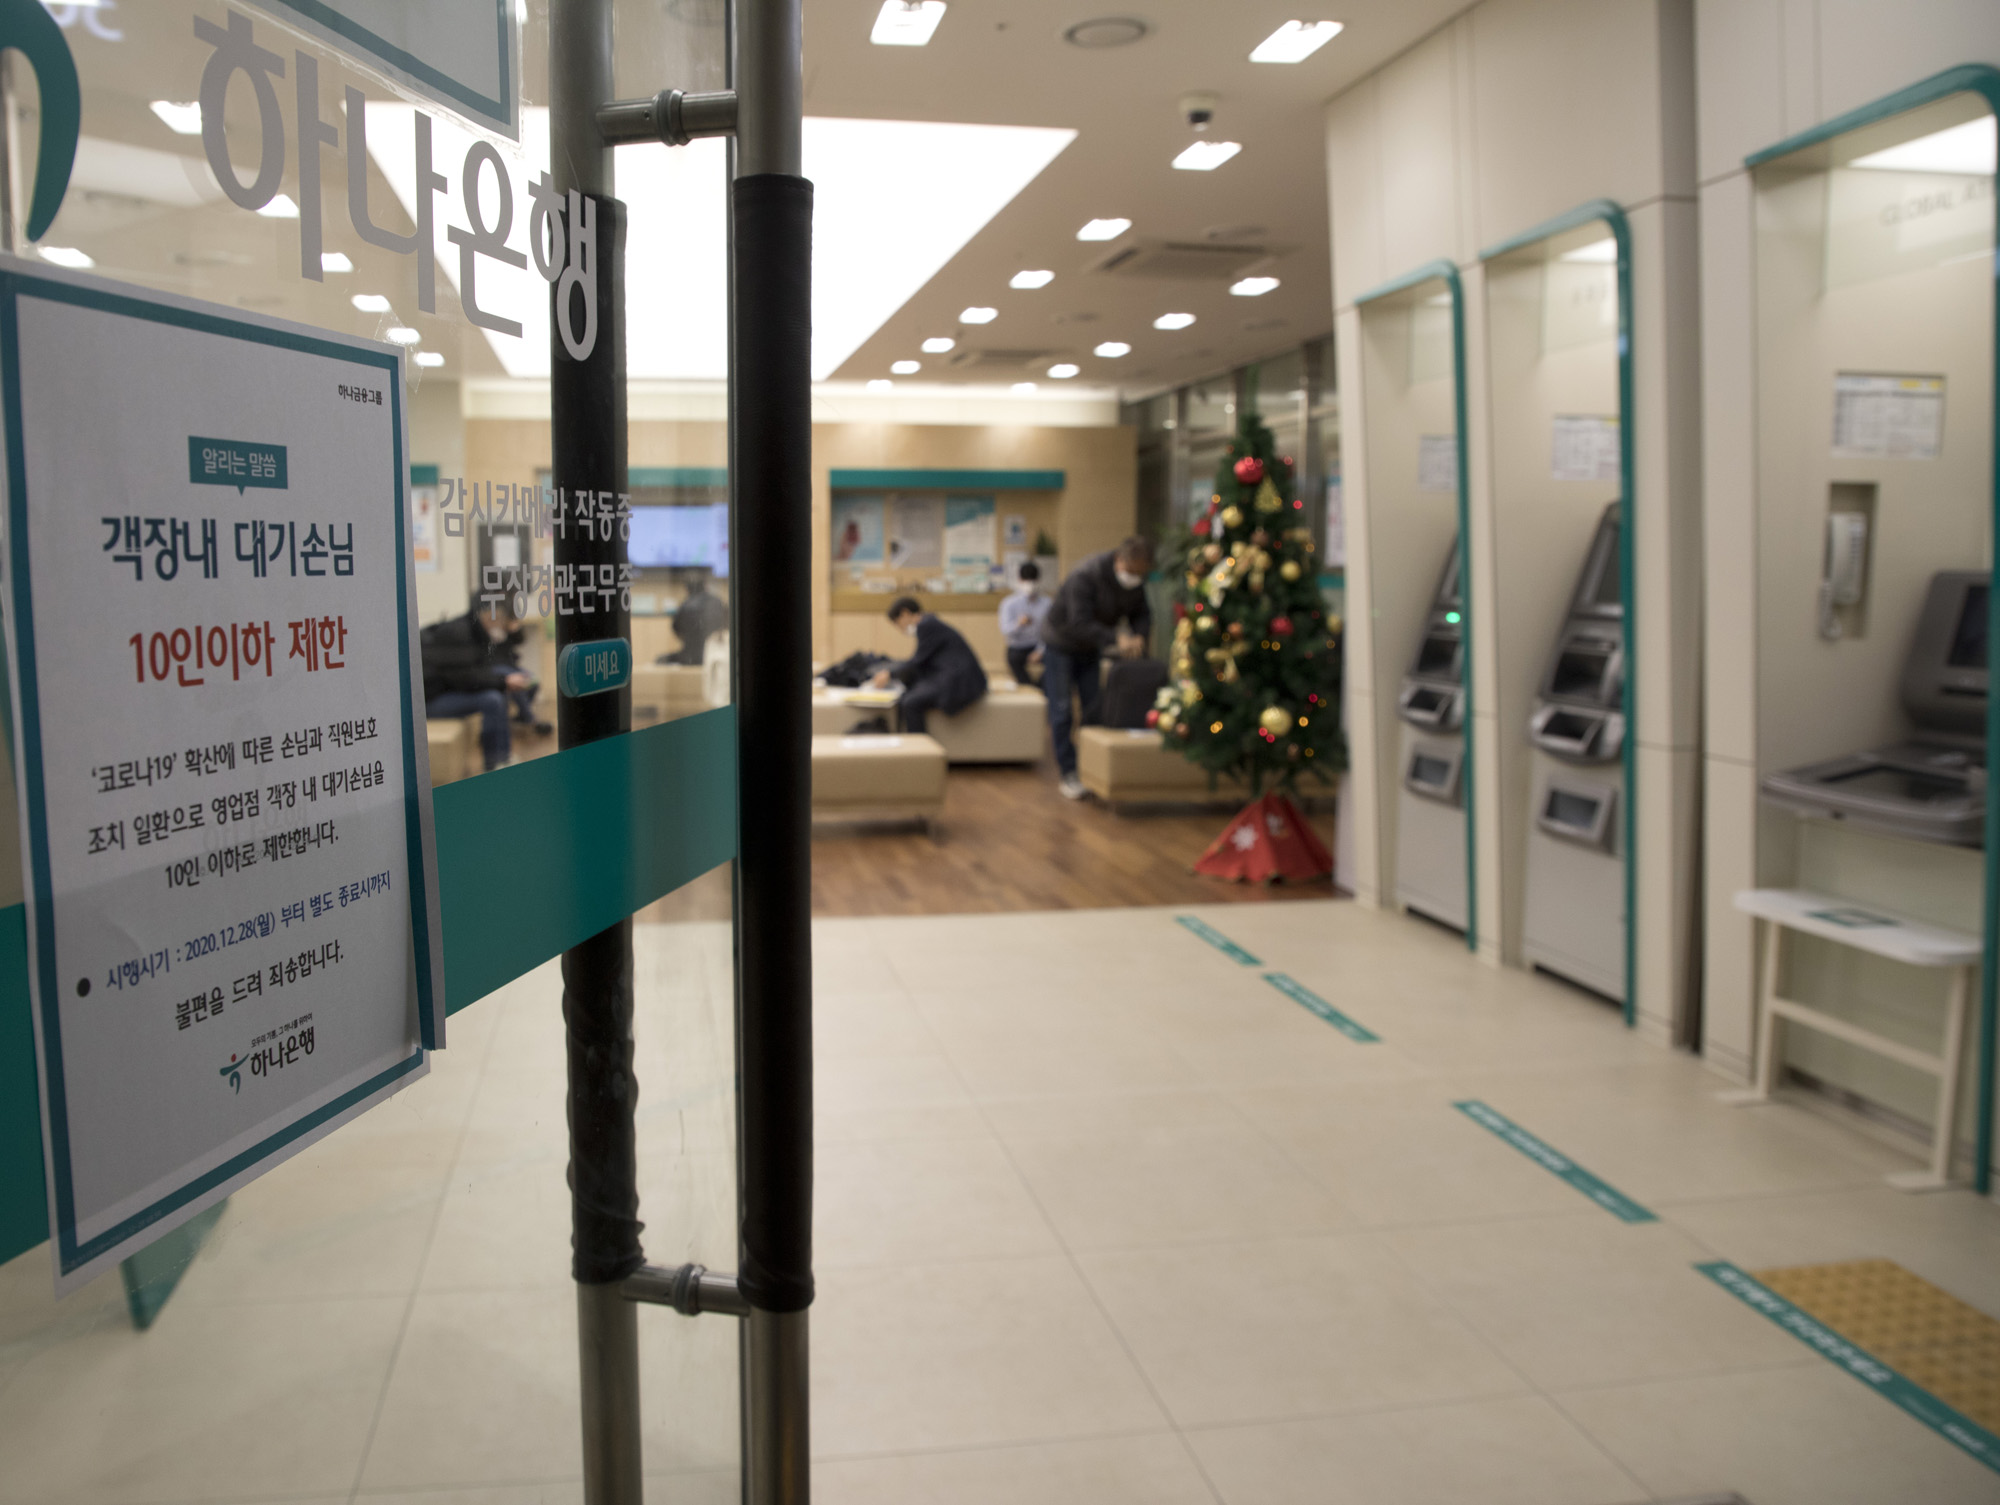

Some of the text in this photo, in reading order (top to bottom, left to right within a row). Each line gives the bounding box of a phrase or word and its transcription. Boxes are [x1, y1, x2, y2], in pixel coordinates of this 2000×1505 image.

[194, 8, 597, 361] 하나은행
[337, 383, 383, 406] 하나금융그룹
[202, 447, 277, 478] 알리는 말씀
[439, 477, 634, 542] 감시카메라 작동중
[101, 515, 354, 582] 객장내 대기손님
[129, 615, 348, 688] 10인이하 제한
[584, 649, 620, 683] 미세요
[184, 741, 236, 777] 확산에
[242, 735, 274, 765] 따른
[280, 726, 323, 759] 손님과
[328, 716, 379, 749] 직원보호
[88, 760, 385, 855] 조치 일환으로 영업점 객장 내 대기손님을
[165, 819, 340, 889] 10인 이하로 제한합니다.
[106, 947, 171, 991] 시행시기
[184, 910, 276, 962] 2020.12.28(월)
[280, 900, 306, 929] 부터
[309, 891, 335, 919] 별도
[338, 870, 391, 908] 종료시까지
[175, 938, 345, 1032] 불편을 드려 죄송합니다.
[250, 1026, 315, 1077] 하나은행
